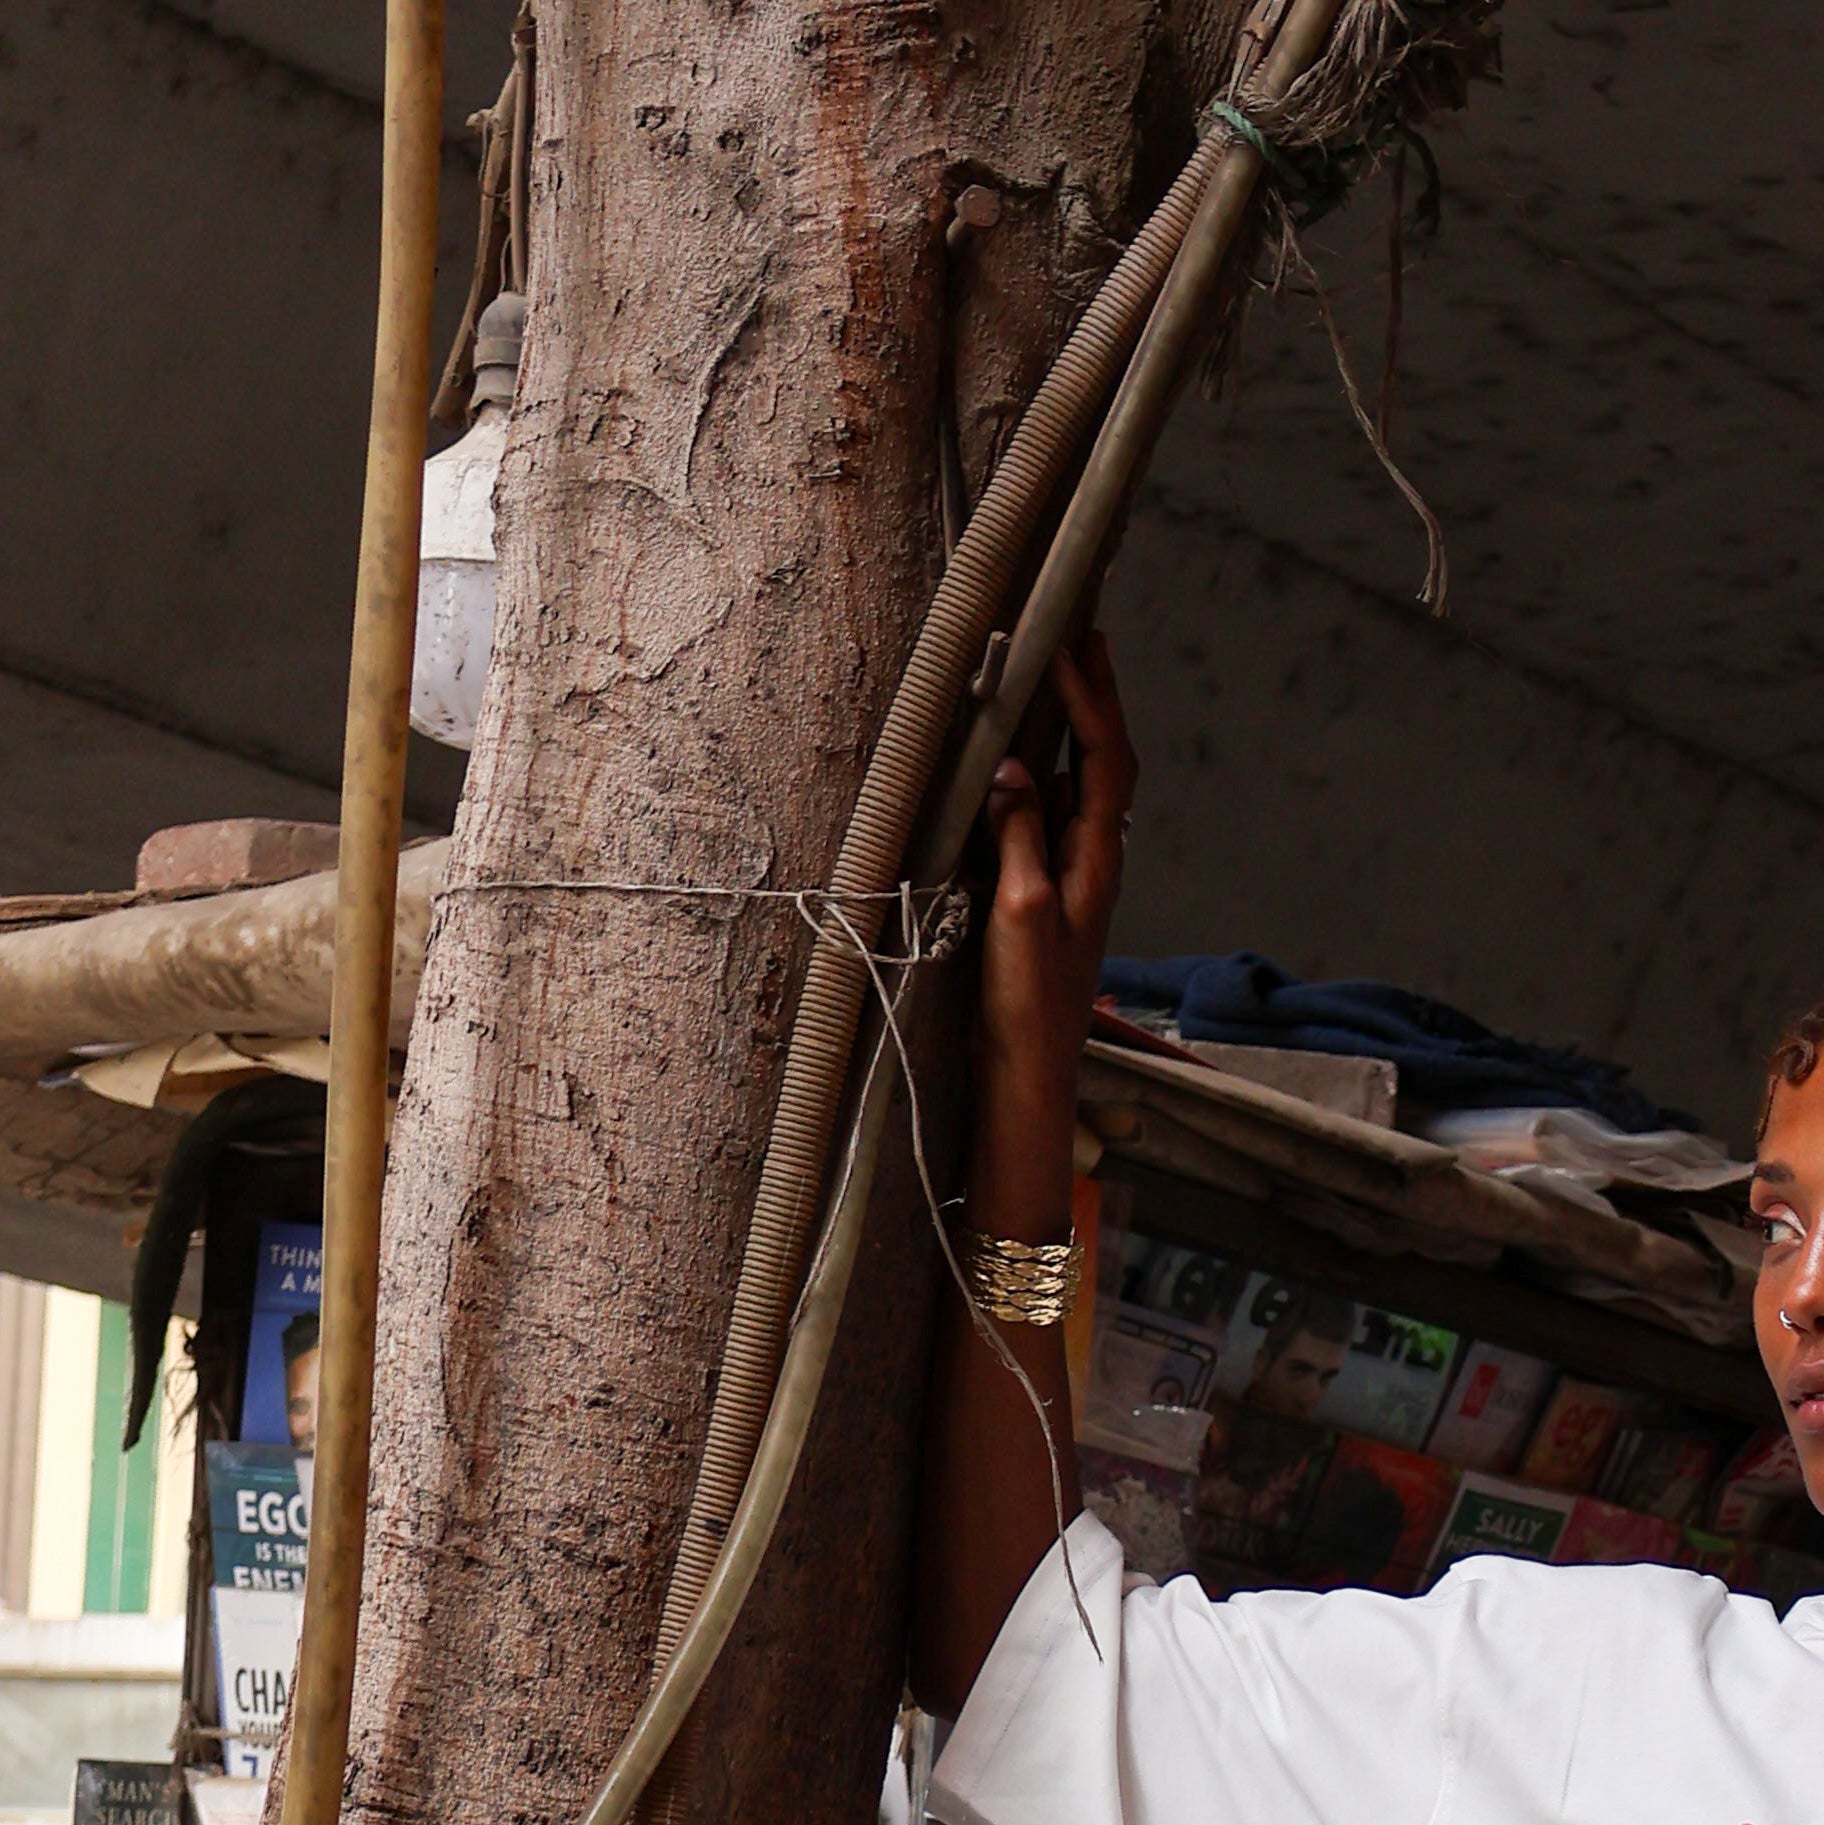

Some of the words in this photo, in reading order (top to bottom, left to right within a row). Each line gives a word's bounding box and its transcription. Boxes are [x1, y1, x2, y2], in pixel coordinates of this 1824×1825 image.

[236, 1489, 312, 1535] EGO
[1474, 1508, 1545, 1546] SALLY
[255, 1542, 272, 1562] IS
[277, 1542, 309, 1566] THE
[233, 1565, 307, 1589] ENE
